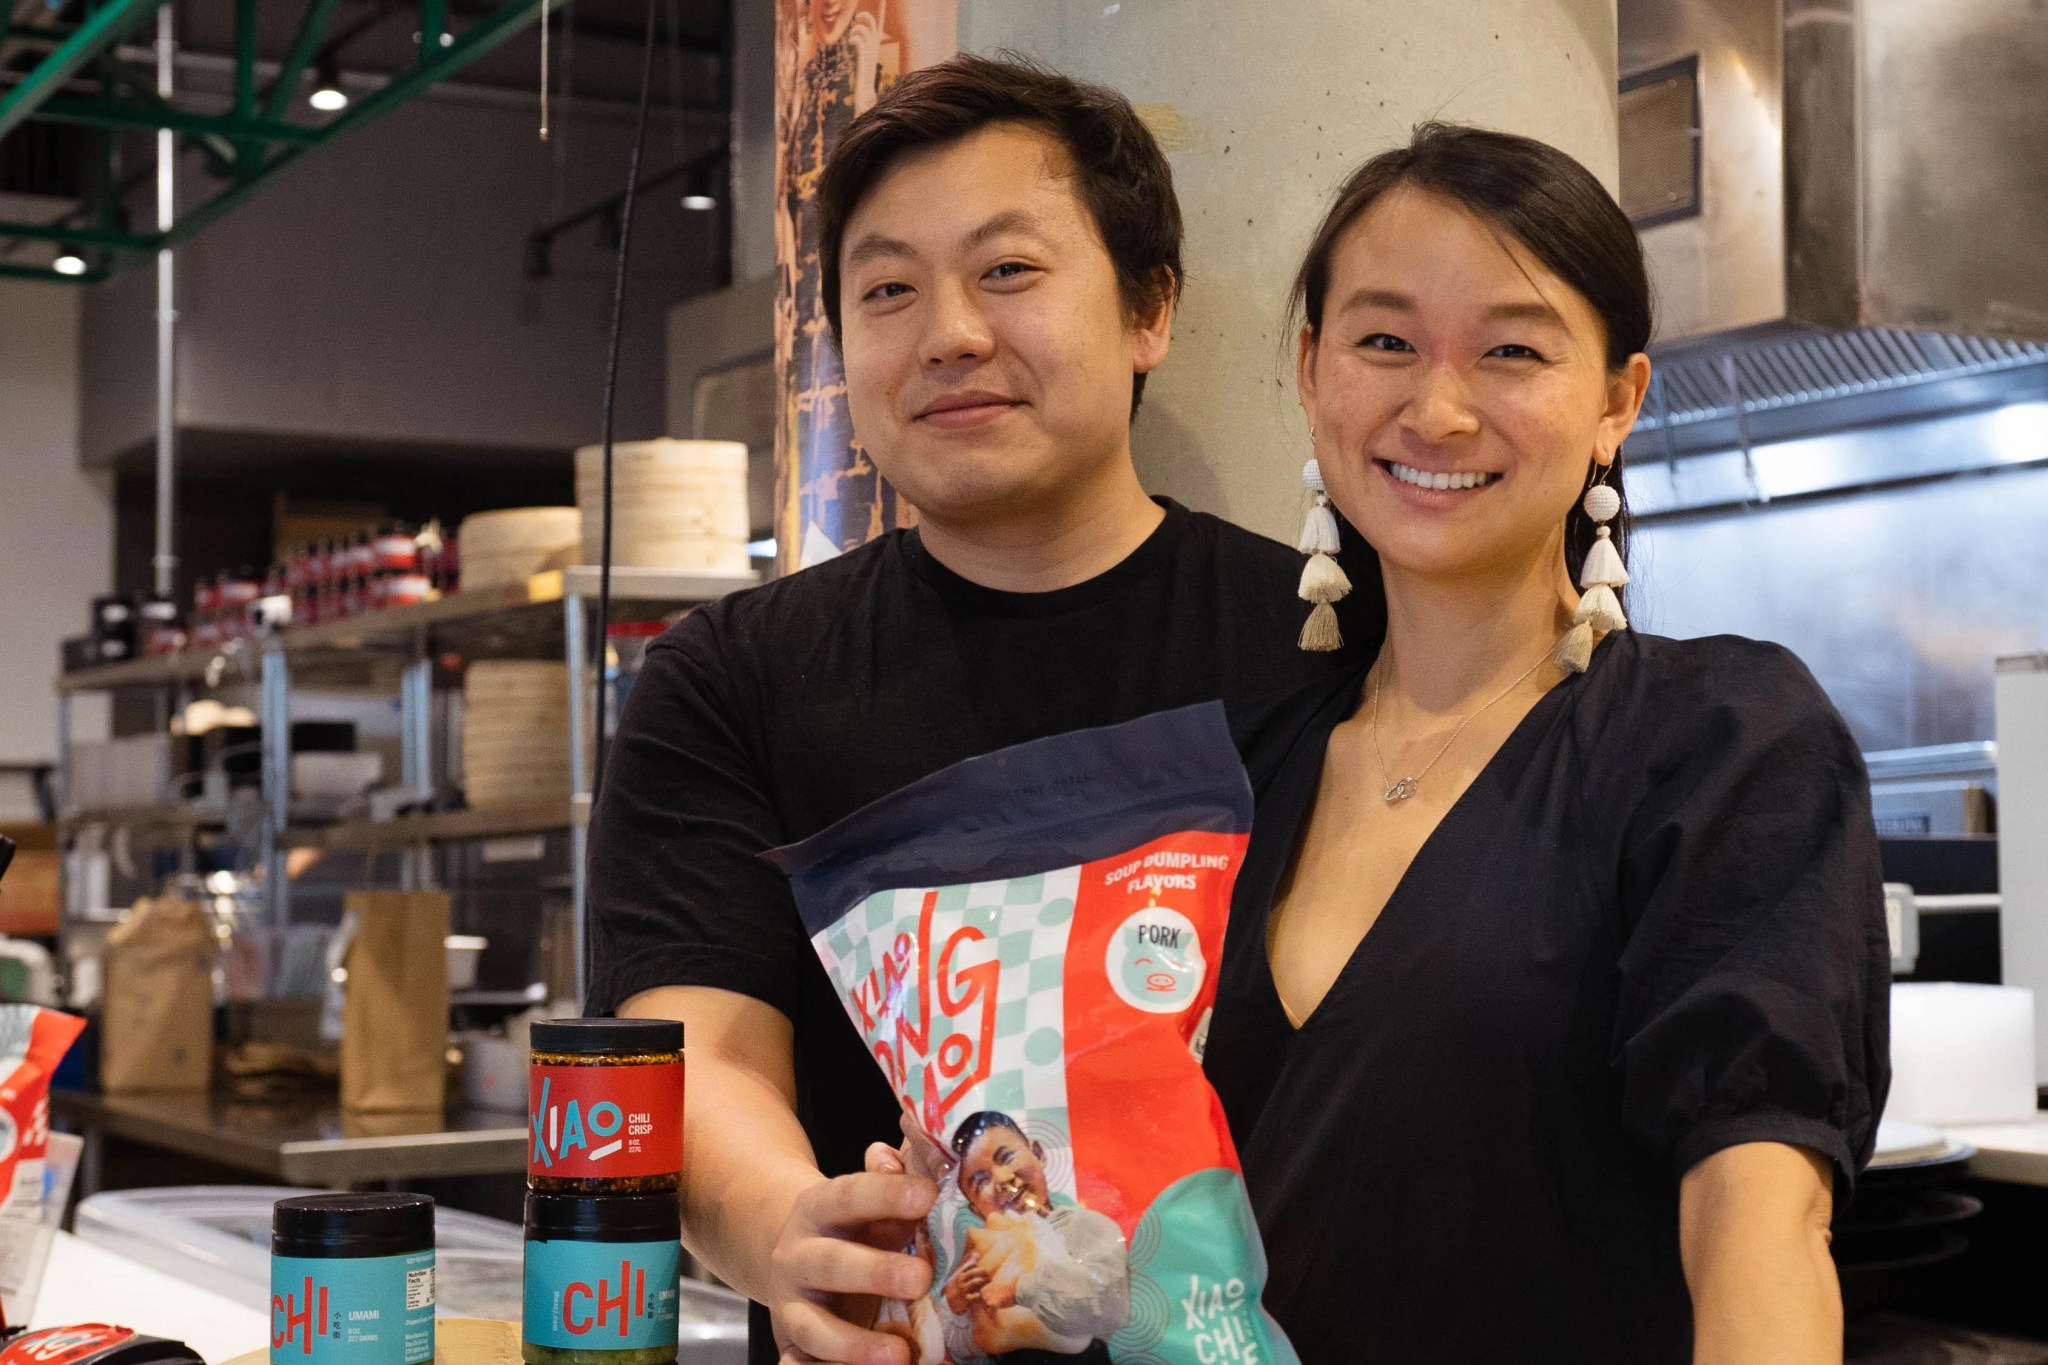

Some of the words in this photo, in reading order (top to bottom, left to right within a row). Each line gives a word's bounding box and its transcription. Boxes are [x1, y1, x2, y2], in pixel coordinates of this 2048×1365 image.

[1104, 860, 1142, 885] SOUP
[1143, 851, 1229, 870] DUMPLING
[1126, 873, 1197, 894] FLAVORS
[1138, 924, 1181, 949] PORK
[531, 1077, 623, 1168] XIAO
[628, 1113, 651, 1124] CHILI
[628, 1124, 653, 1136] CRISP
[271, 1276, 328, 1355] CHI
[348, 1310, 380, 1321] UMAMI
[562, 1260, 645, 1337] CHI
[1181, 1274, 1246, 1330] XIAO
[1194, 1315, 1245, 1364] CHI
